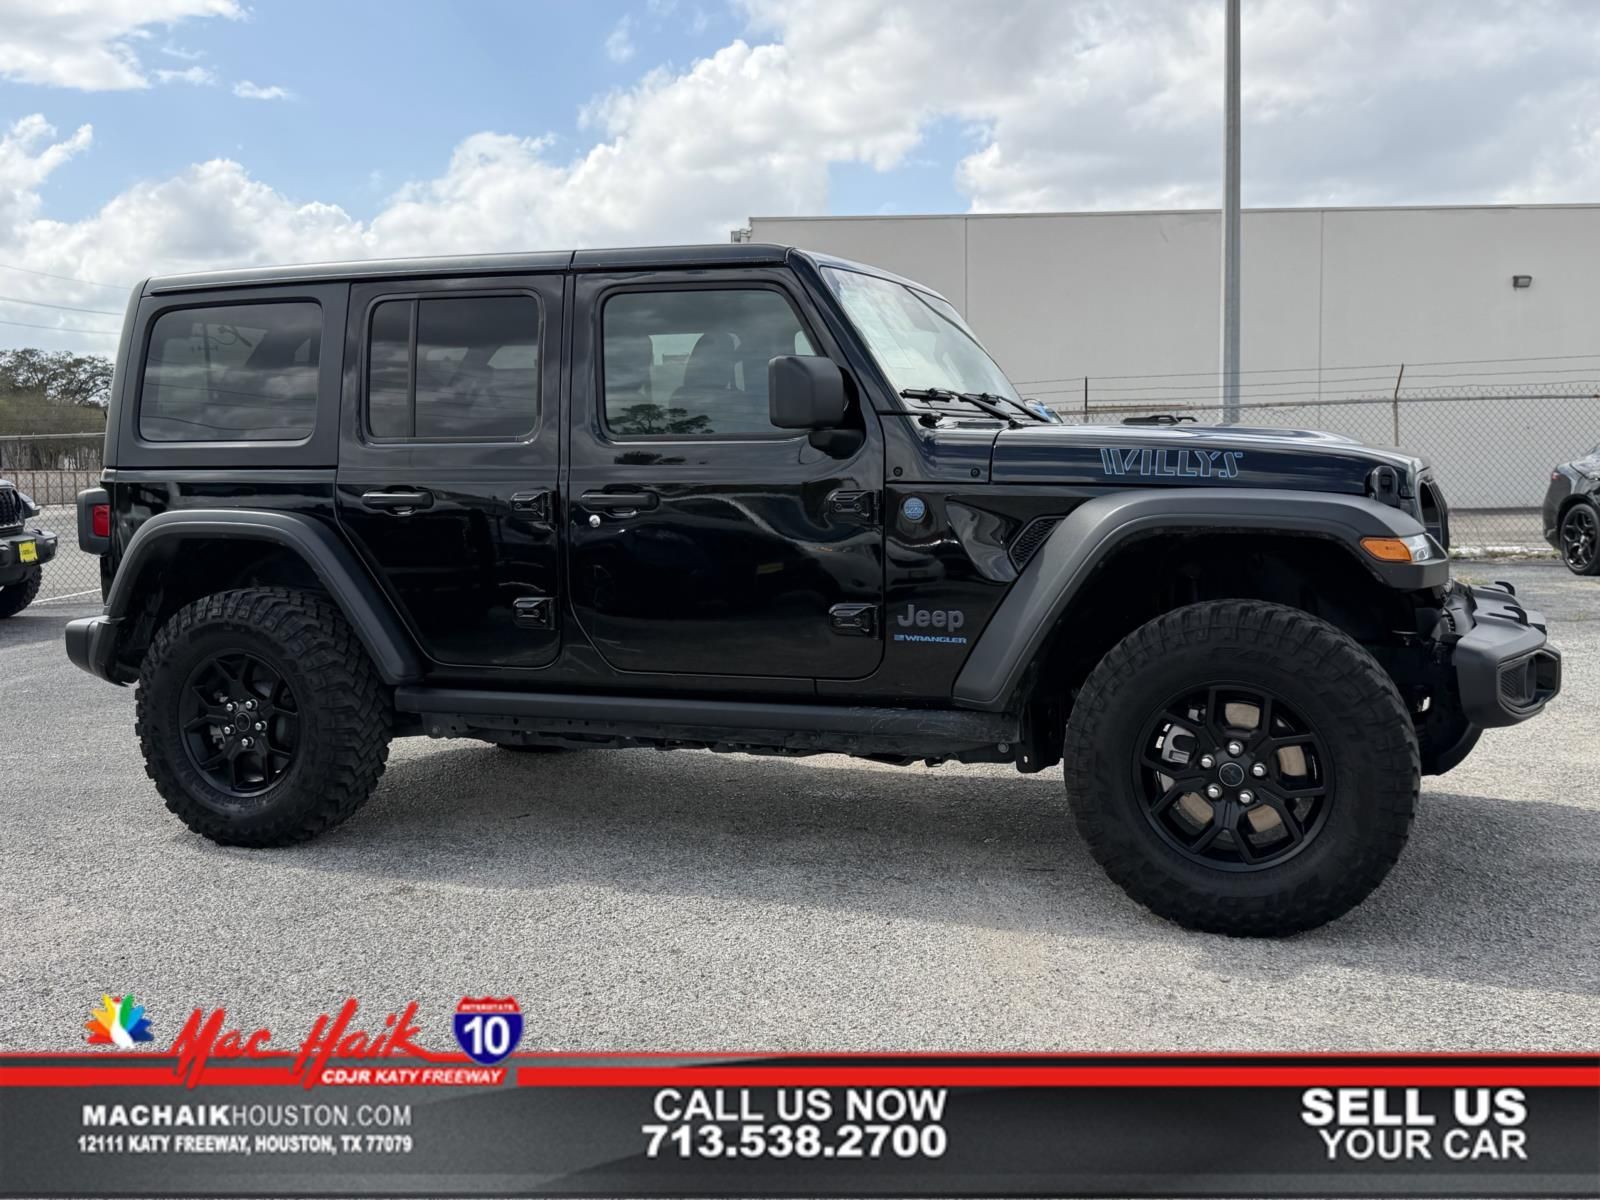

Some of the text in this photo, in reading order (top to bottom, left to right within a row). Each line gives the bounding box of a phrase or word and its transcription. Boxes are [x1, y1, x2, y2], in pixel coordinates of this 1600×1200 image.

[1100, 448, 1244, 478] WILLYS
[896, 603, 965, 633] Jeep
[904, 633, 968, 645] WRANGLER
